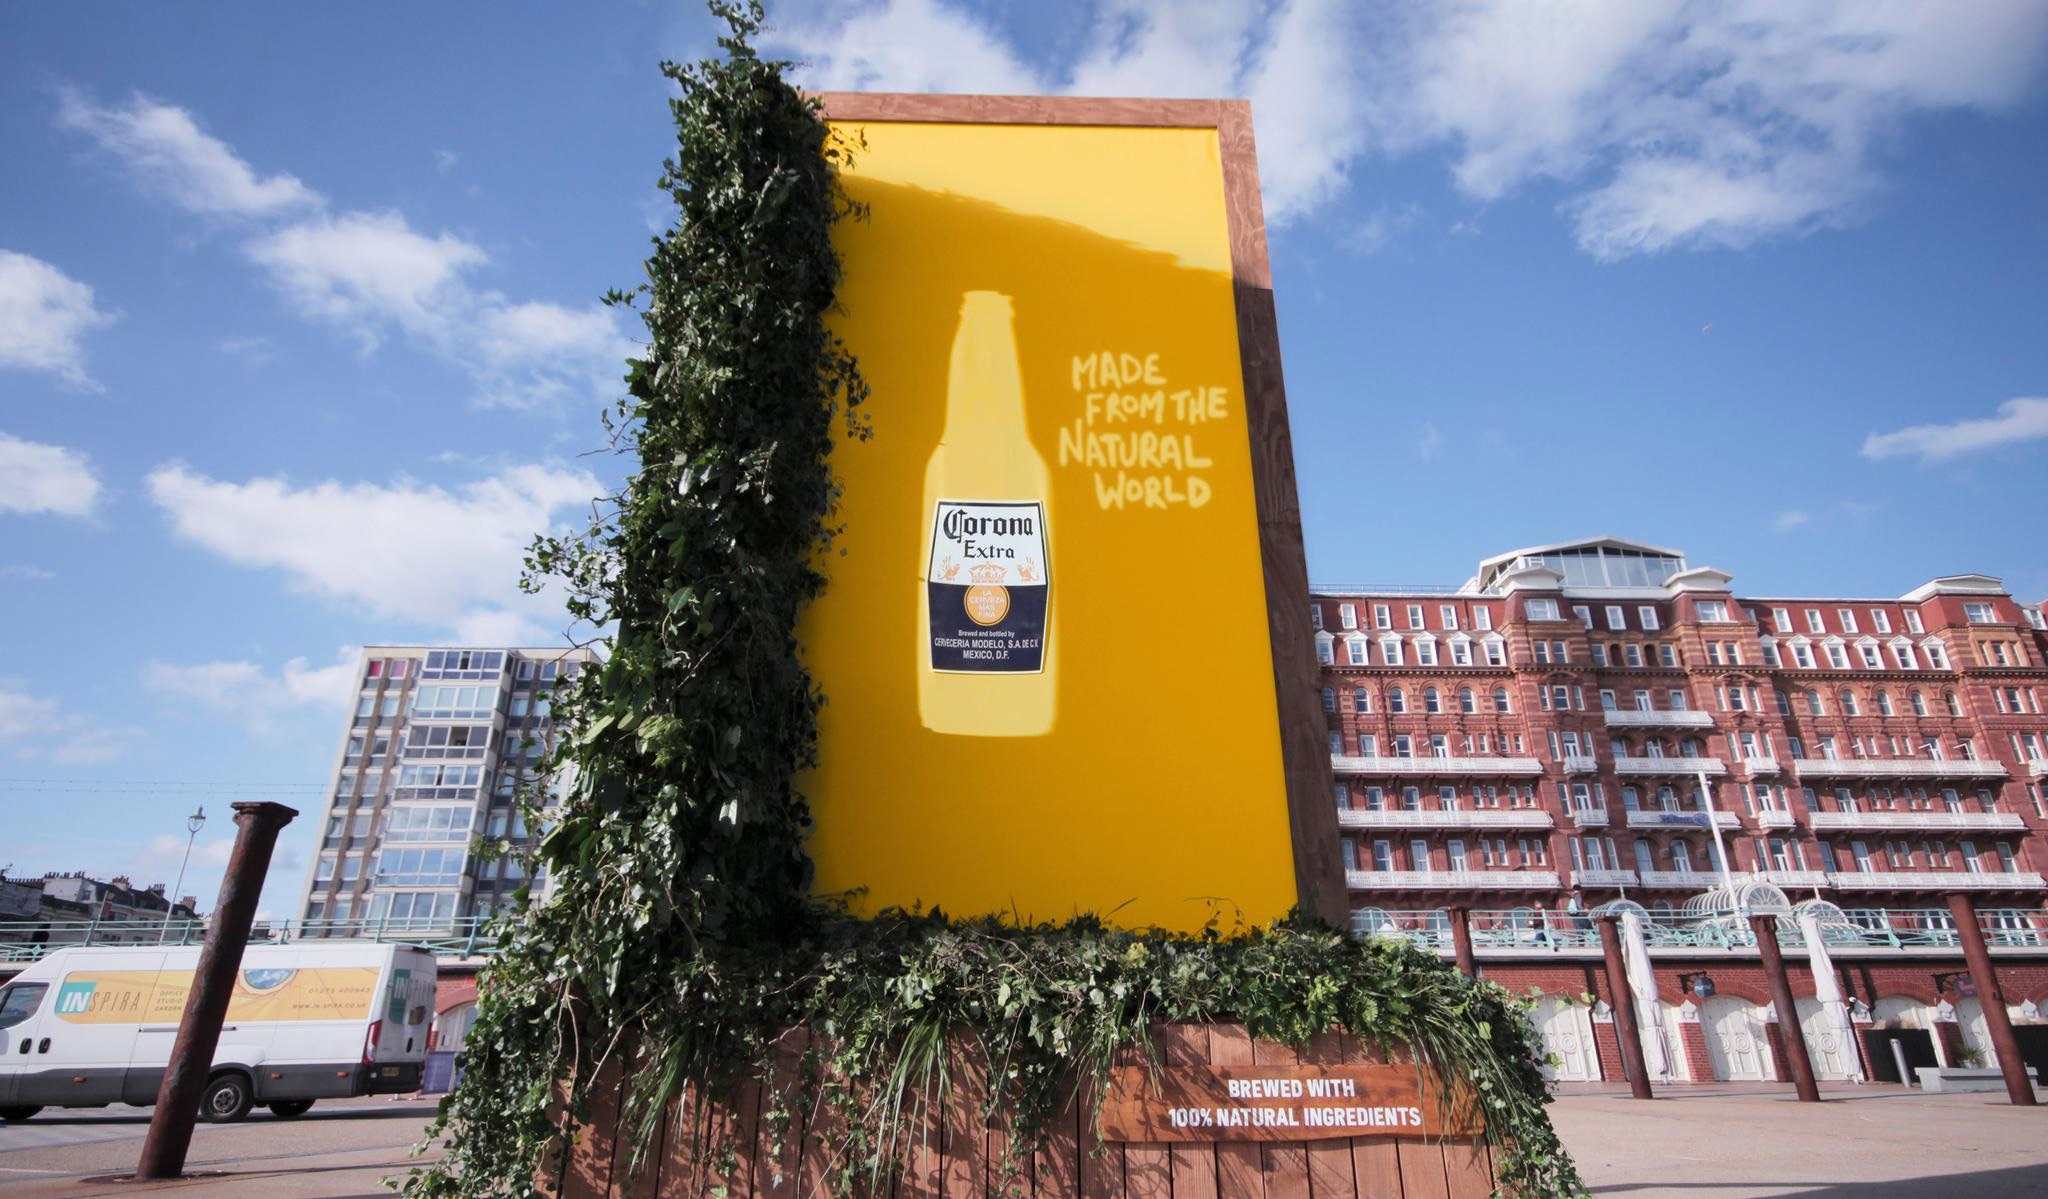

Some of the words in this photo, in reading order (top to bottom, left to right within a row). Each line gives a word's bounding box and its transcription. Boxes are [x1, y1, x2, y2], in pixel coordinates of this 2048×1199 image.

[1071, 351, 1167, 391] MADE
[1086, 390, 1165, 426] FROM
[1169, 386, 1229, 426] THE
[1058, 418, 1213, 471] NATURAL
[1094, 470, 1212, 511] WORLD
[943, 508, 1034, 544] Corona
[963, 540, 1015, 559] Extra
[935, 638, 970, 648] CERVECERIA
[972, 639, 1006, 650] MODELO,
[1022, 640, 1030, 648] DE
[962, 650, 995, 661] MEXICO,
[996, 650, 1010, 660] D.F.
[1228, 1079, 1303, 1098] BREWED
[1306, 1078, 1355, 1097] WITH
[1168, 1108, 1212, 1128] 100%
[1216, 1107, 1299, 1127] NATURAL
[1303, 1106, 1422, 1127] INGREDIENTS
